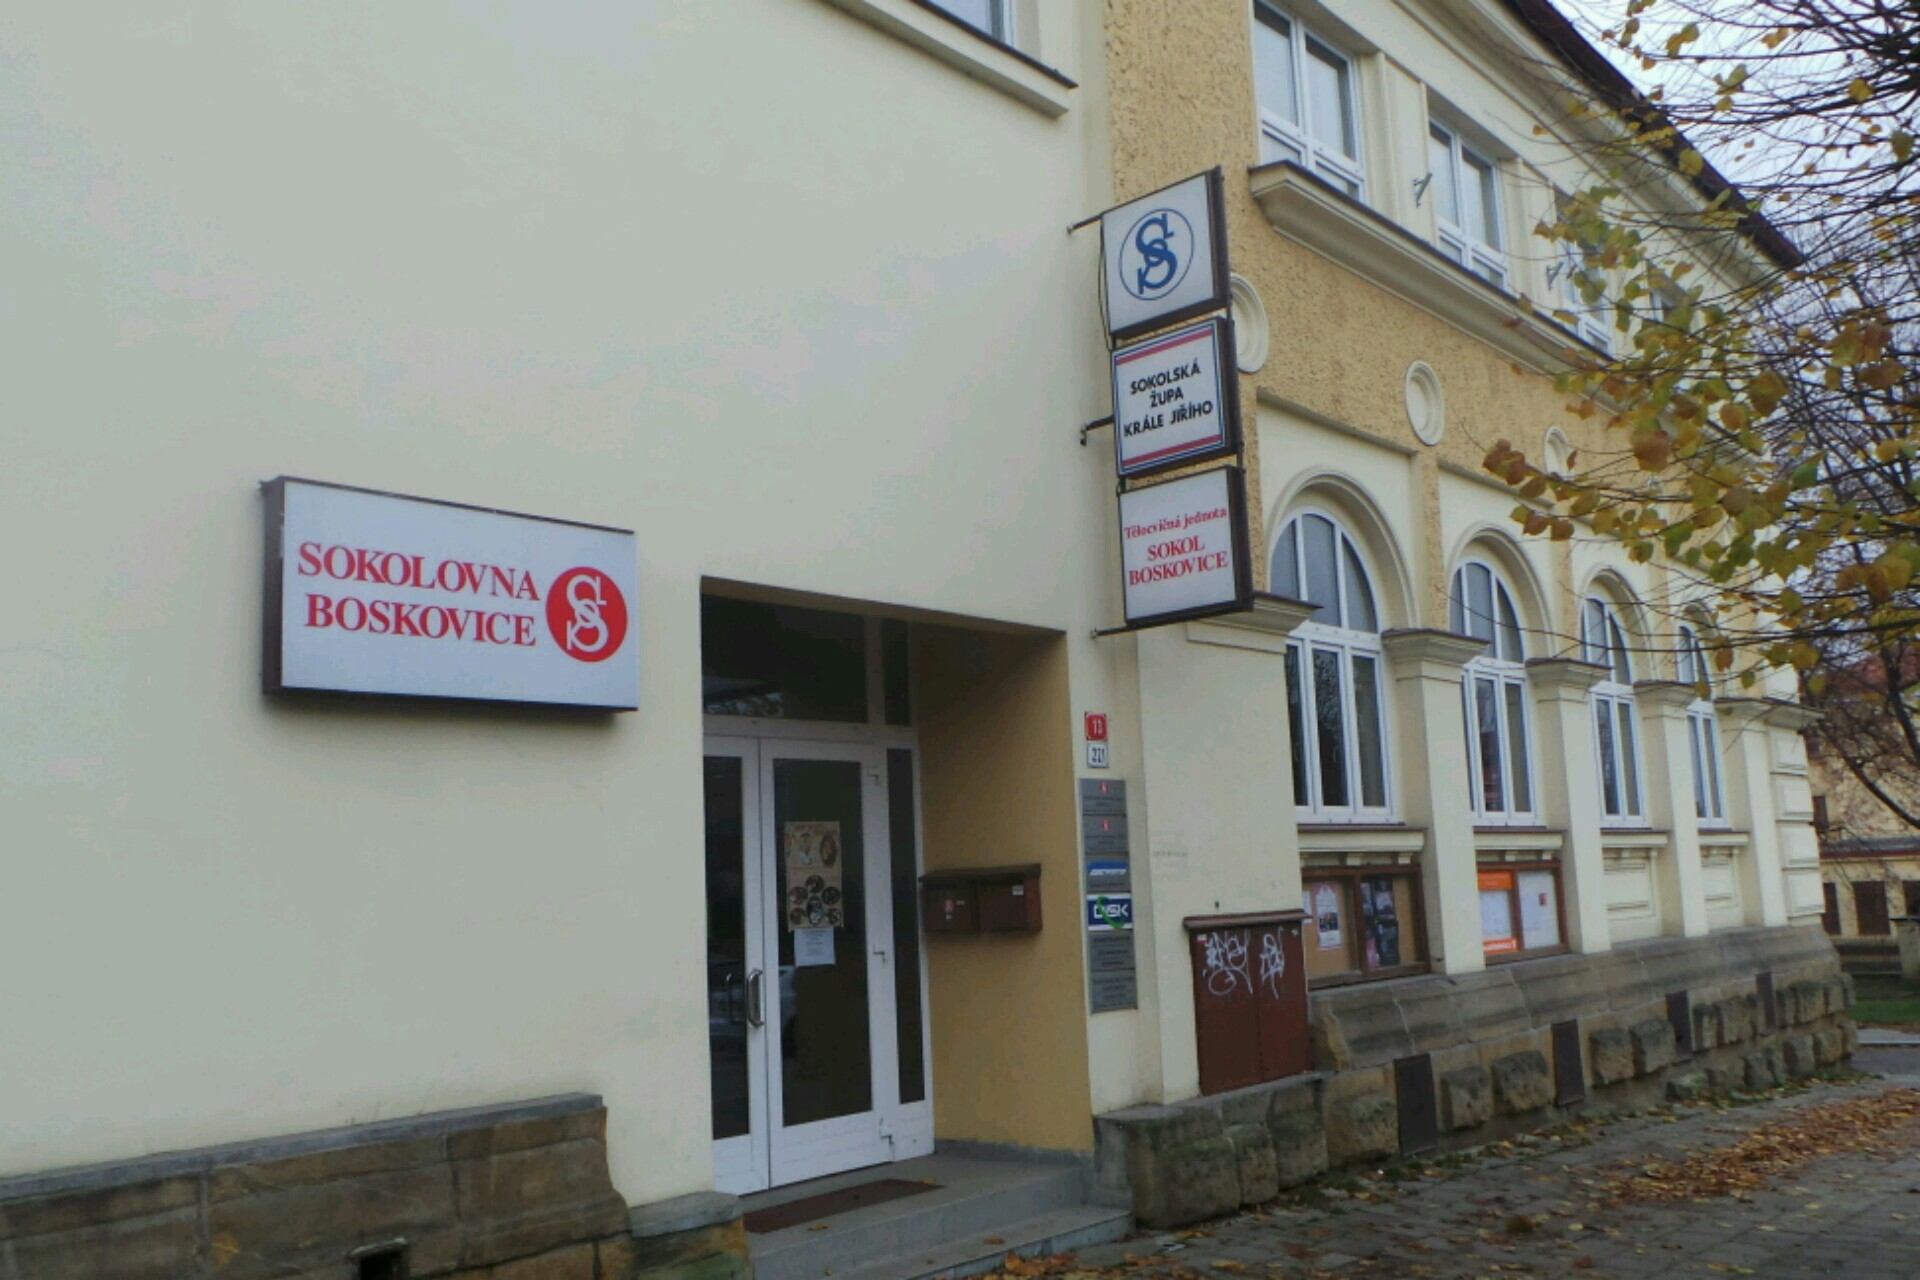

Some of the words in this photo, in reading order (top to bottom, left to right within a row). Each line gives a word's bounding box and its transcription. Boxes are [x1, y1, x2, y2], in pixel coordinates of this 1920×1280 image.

[1130, 357, 1201, 395] SOKOLSKÁ
[1150, 386, 1184, 408] ŽUPA
[1123, 414, 1164, 437] KRÁLE
[1169, 400, 1213, 425] JIŘÍHO
[1183, 507, 1228, 530] jednota
[1147, 535, 1205, 561] SOKOL
[297, 541, 540, 601] SOKOLOVNA
[1128, 550, 1229, 587] BOSKOVICE
[304, 593, 537, 647] BOSKOVICE
